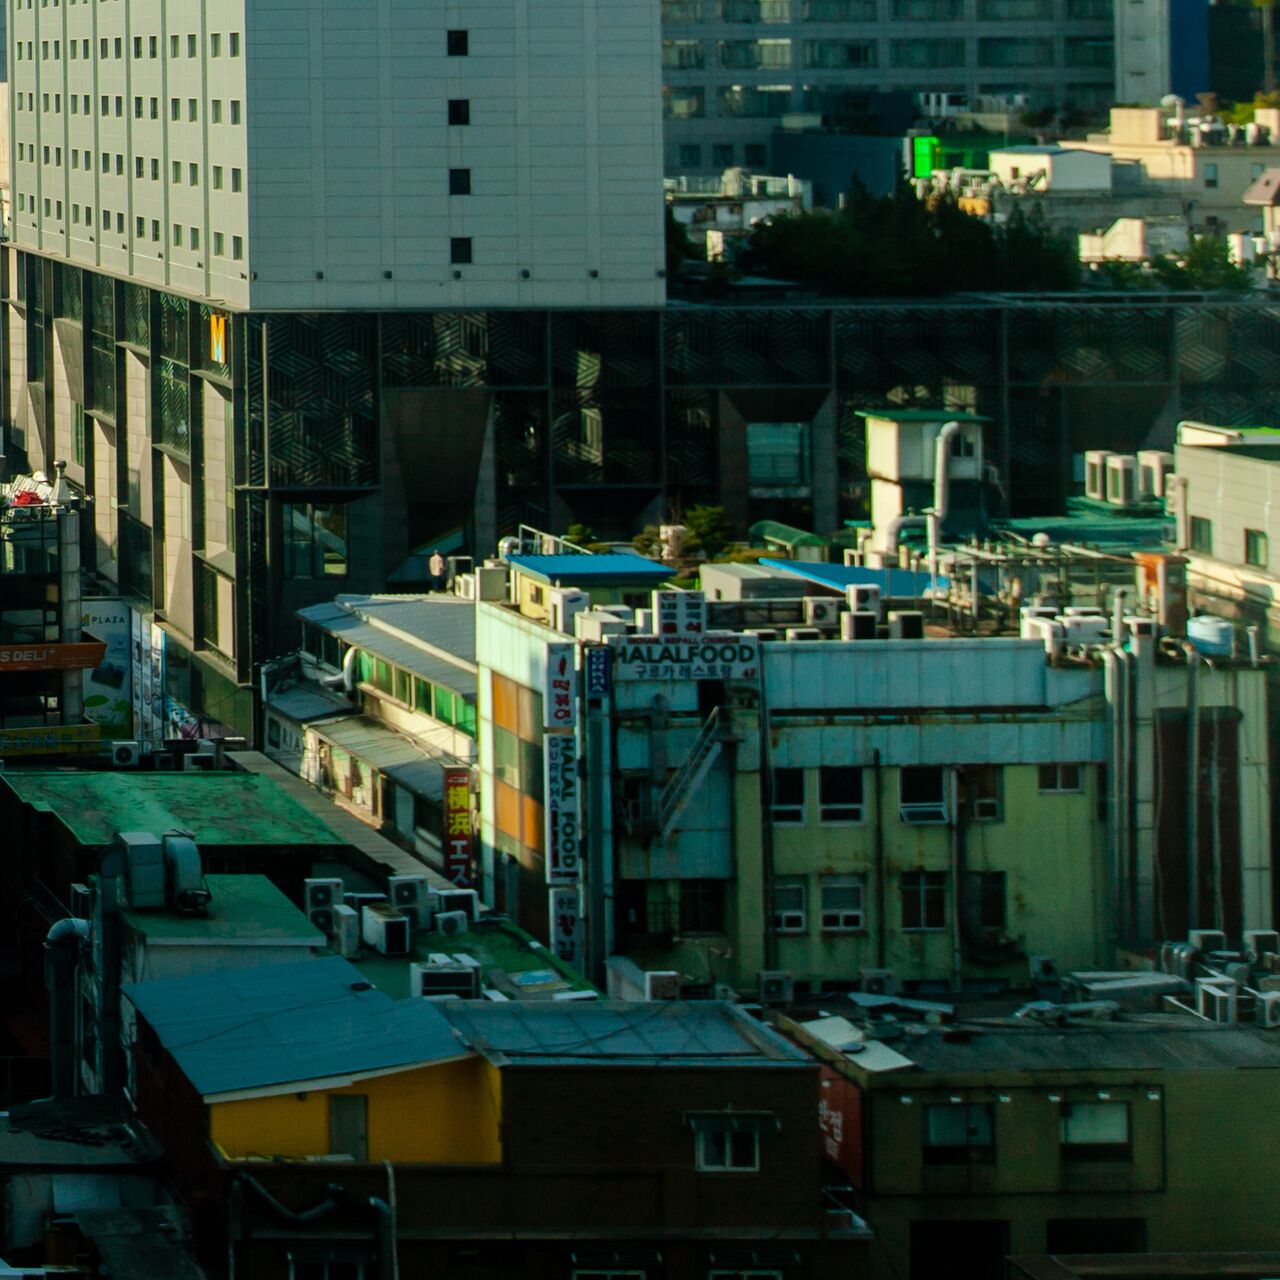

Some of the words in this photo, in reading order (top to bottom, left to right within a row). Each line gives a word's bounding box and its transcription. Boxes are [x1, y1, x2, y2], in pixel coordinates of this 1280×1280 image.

[91, 616, 125, 624] PLAZA
[12, 649, 47, 662] DELI
[561, 738, 575, 802] HALAL
[562, 812, 576, 868] FOOD
